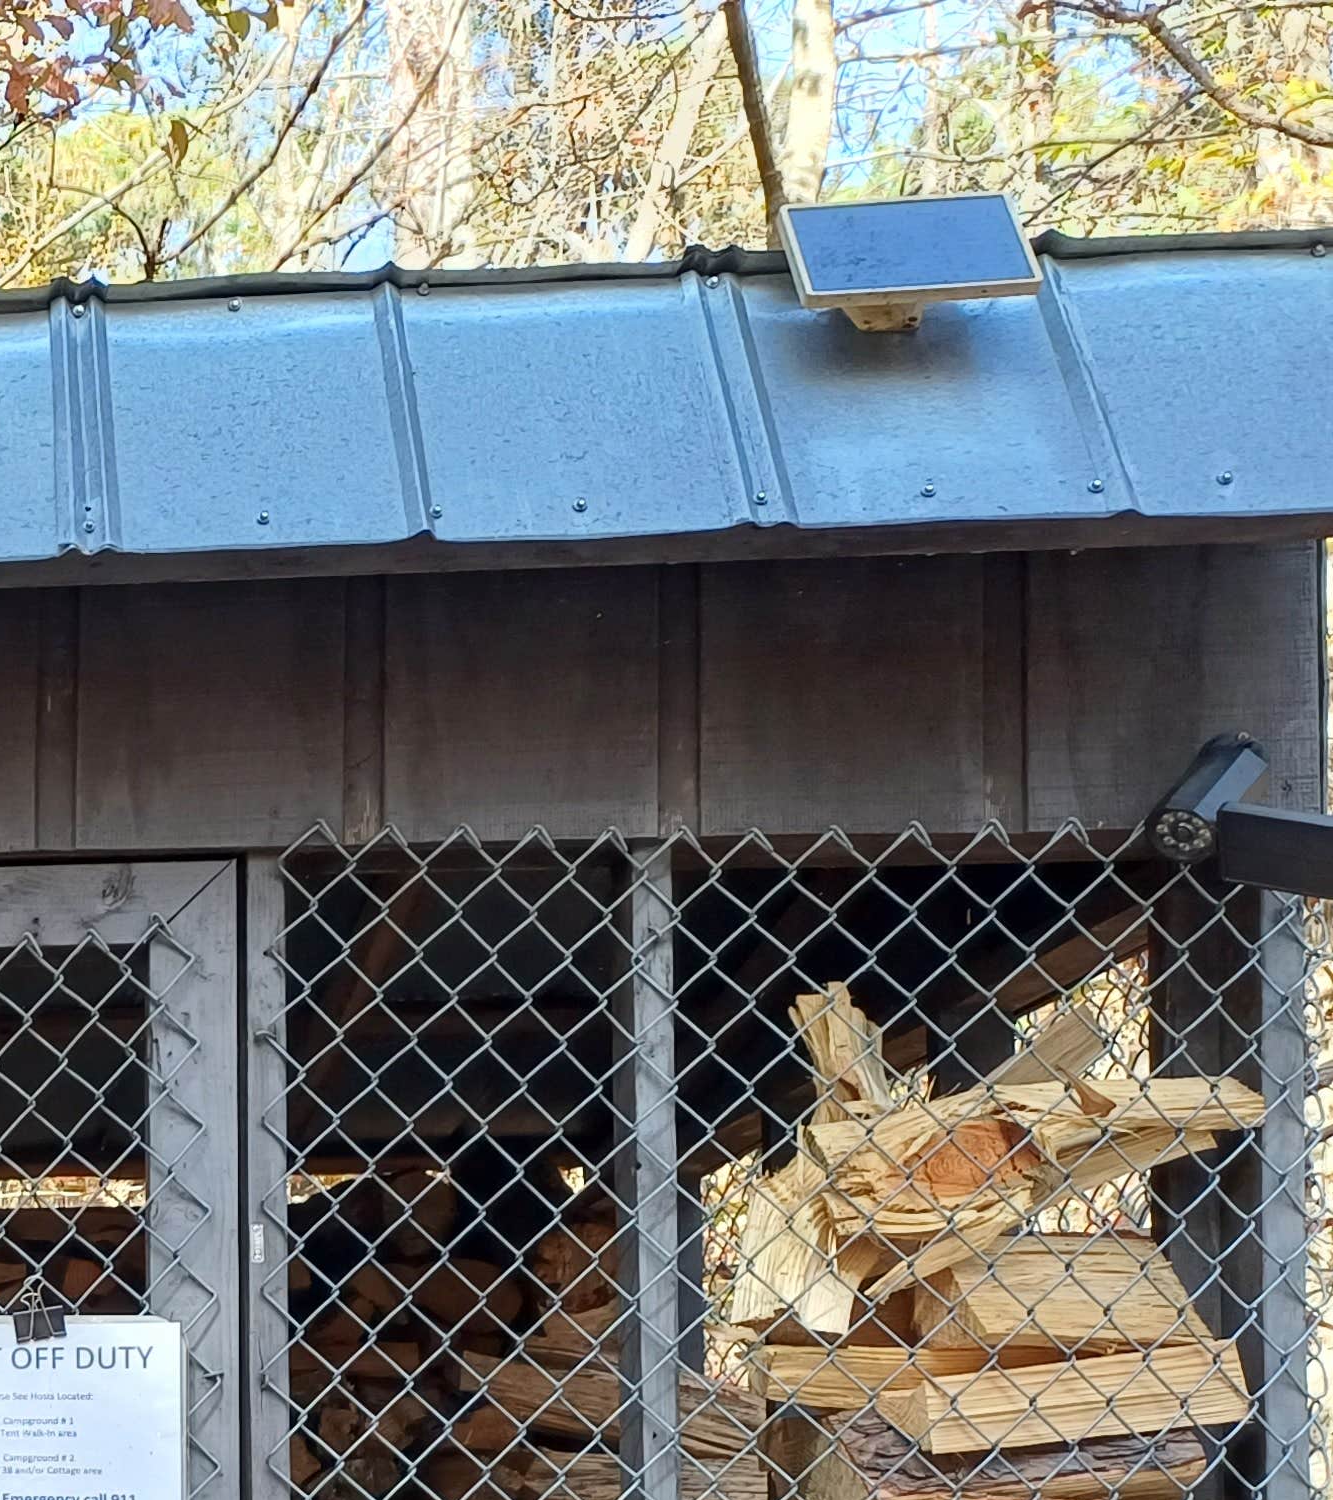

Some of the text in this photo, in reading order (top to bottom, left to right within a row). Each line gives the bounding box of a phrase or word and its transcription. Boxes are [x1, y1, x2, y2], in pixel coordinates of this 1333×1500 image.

[11, 1347, 65, 1370] OFF
[76, 1345, 153, 1370] DUTY
[3, 1417, 58, 1425] Campground
[1, 1429, 19, 1437] Tent
[3, 1454, 59, 1463] Campground
[2, 1466, 12, 1474] 38
[15, 1466, 43, 1474] and/or
[47, 1466, 80, 1475] Cottage
